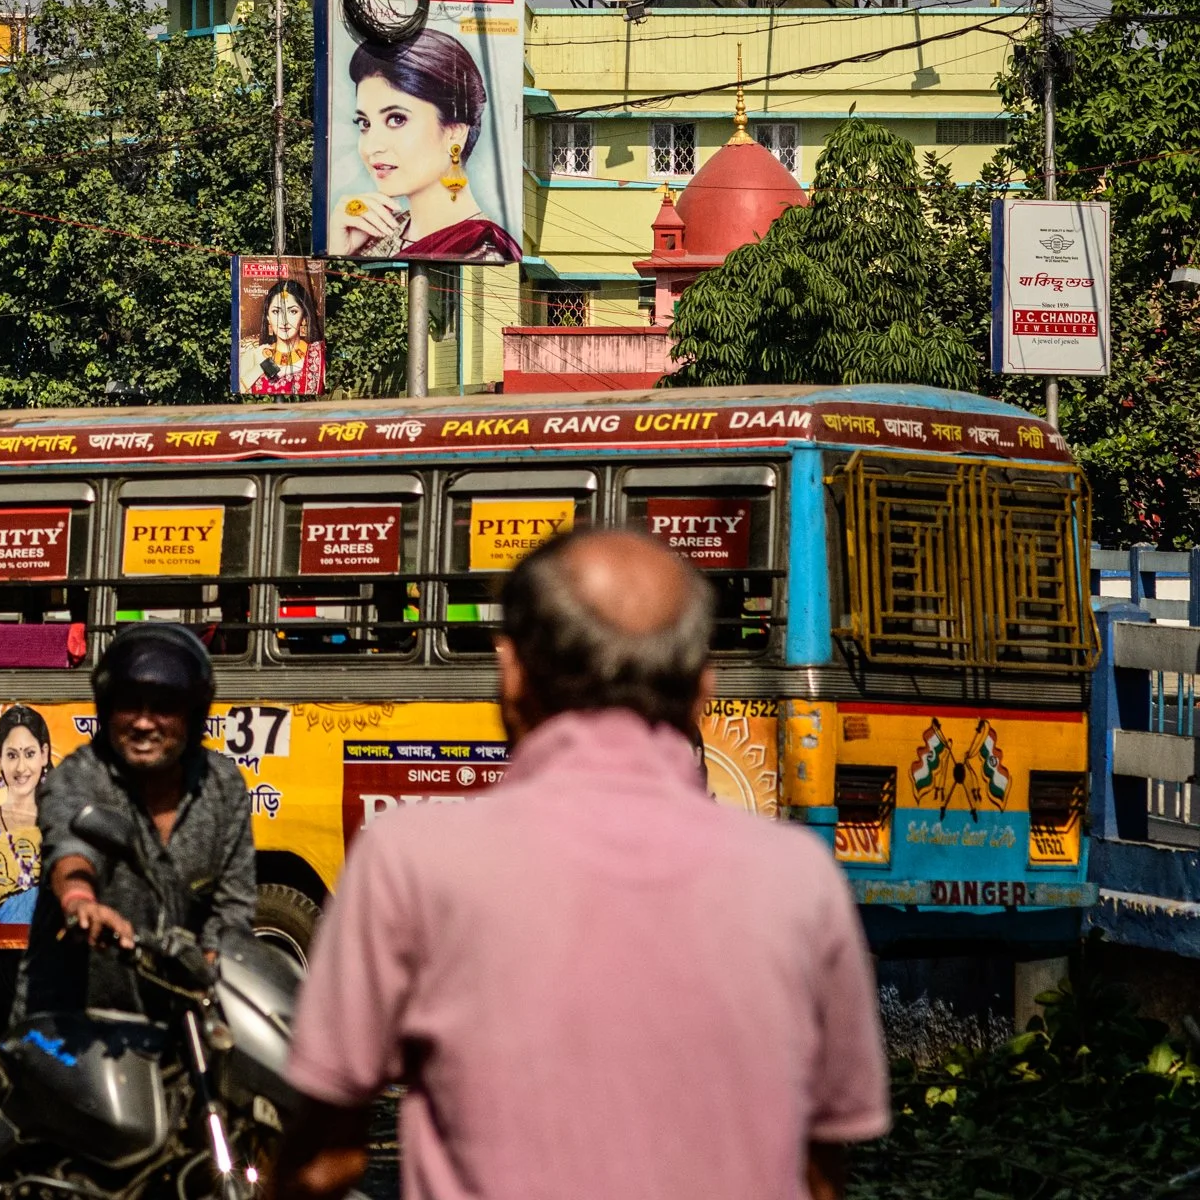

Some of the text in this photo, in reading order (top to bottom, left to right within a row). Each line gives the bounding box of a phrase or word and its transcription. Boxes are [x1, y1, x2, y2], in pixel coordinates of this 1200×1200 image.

[1018, 272, 1096, 292] যা কিছু শুভ
[1014, 311, 1096, 324] P. C. CHANDRA
[1014, 324, 1097, 334] JEWELLERS
[1037, 338, 1053, 346] jewel
[1060, 338, 1080, 346] jewels
[441, 410, 813, 437] PAKKA RANG UCHIT DAAM
[822, 414, 881, 438] আপনার,
[883, 417, 928, 443] আমার,
[931, 422, 962, 442] সবার
[88, 432, 156, 452] আমার,
[165, 430, 221, 448] সবার
[375, 420, 427, 442] শাড়ি
[478, 518, 565, 536] PITTY
[652, 515, 744, 534] PITTY
[132, 525, 214, 542] PITTY
[307, 523, 394, 542] PITTY
[147, 545, 195, 555] SAREES
[323, 544, 374, 554] SAREES
[669, 537, 722, 548] SAREES
[16, 561, 51, 569] COTTON
[344, 557, 380, 565] COTTON
[226, 706, 290, 754] 37
[347, 745, 394, 759] আপনার,
[397, 745, 437, 759] আমার,
[440, 745, 471, 757] সবার
[408, 770, 451, 783] SINCE
[933, 880, 1027, 906] DANGER
